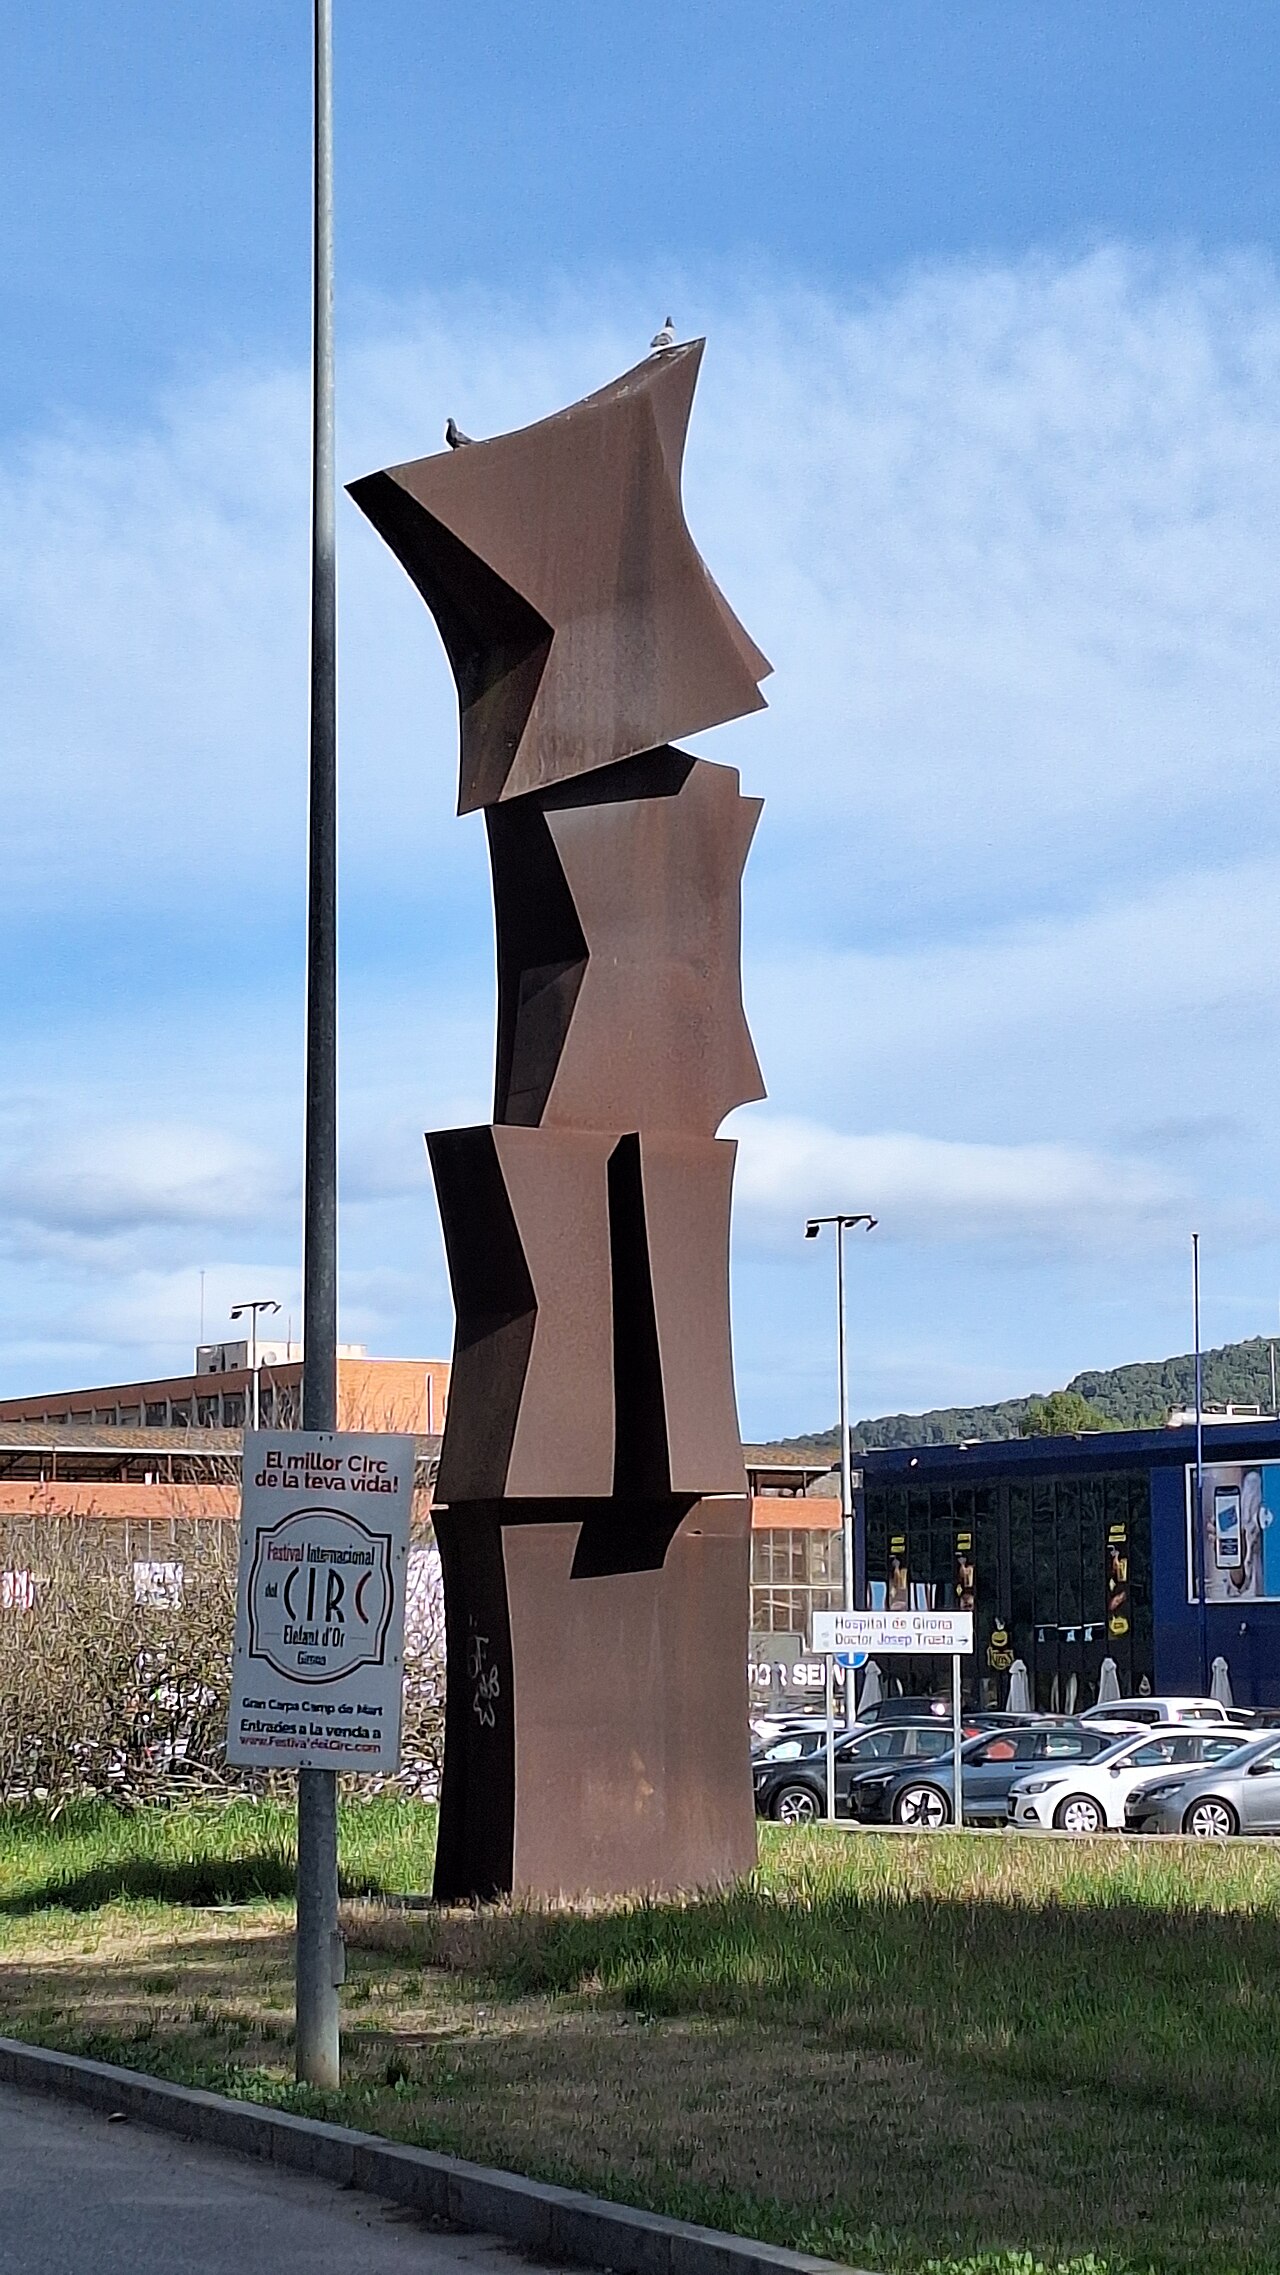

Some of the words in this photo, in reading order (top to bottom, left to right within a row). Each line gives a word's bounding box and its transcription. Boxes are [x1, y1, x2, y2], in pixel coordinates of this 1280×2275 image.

[266, 1451, 283, 1469] El
[287, 1452, 343, 1470] millor
[255, 1470, 278, 1487] de
[282, 1471, 299, 1488] la
[304, 1472, 346, 1490] teva
[350, 1475, 398, 1493] vida!
[267, 1541, 304, 1562] Festival
[307, 1543, 375, 1566] Internacional
[265, 1582, 278, 1598] del
[283, 1566, 372, 1624] CIRC
[835, 1617, 887, 1633] Hospital
[892, 1618, 907, 1630] de
[912, 1617, 952, 1630] Girona
[283, 1624, 319, 1646] Elefant
[321, 1627, 345, 1648] d'Or
[835, 1633, 872, 1646] Doctor
[876, 1633, 912, 1647] Josep
[915, 1633, 953, 1645] Trueta
[297, 1651, 326, 1666] Girona
[242, 1698, 266, 1709] Gran
[268, 1700, 299, 1715] Carpa
[301, 1702, 335, 1715] Camp
[337, 1704, 353, 1714] de
[240, 1719, 297, 1734] Entrades
[299, 1724, 307, 1735] a
[309, 1722, 323, 1736] la
[326, 1726, 370, 1739] venda
[372, 1728, 382, 1739] a
